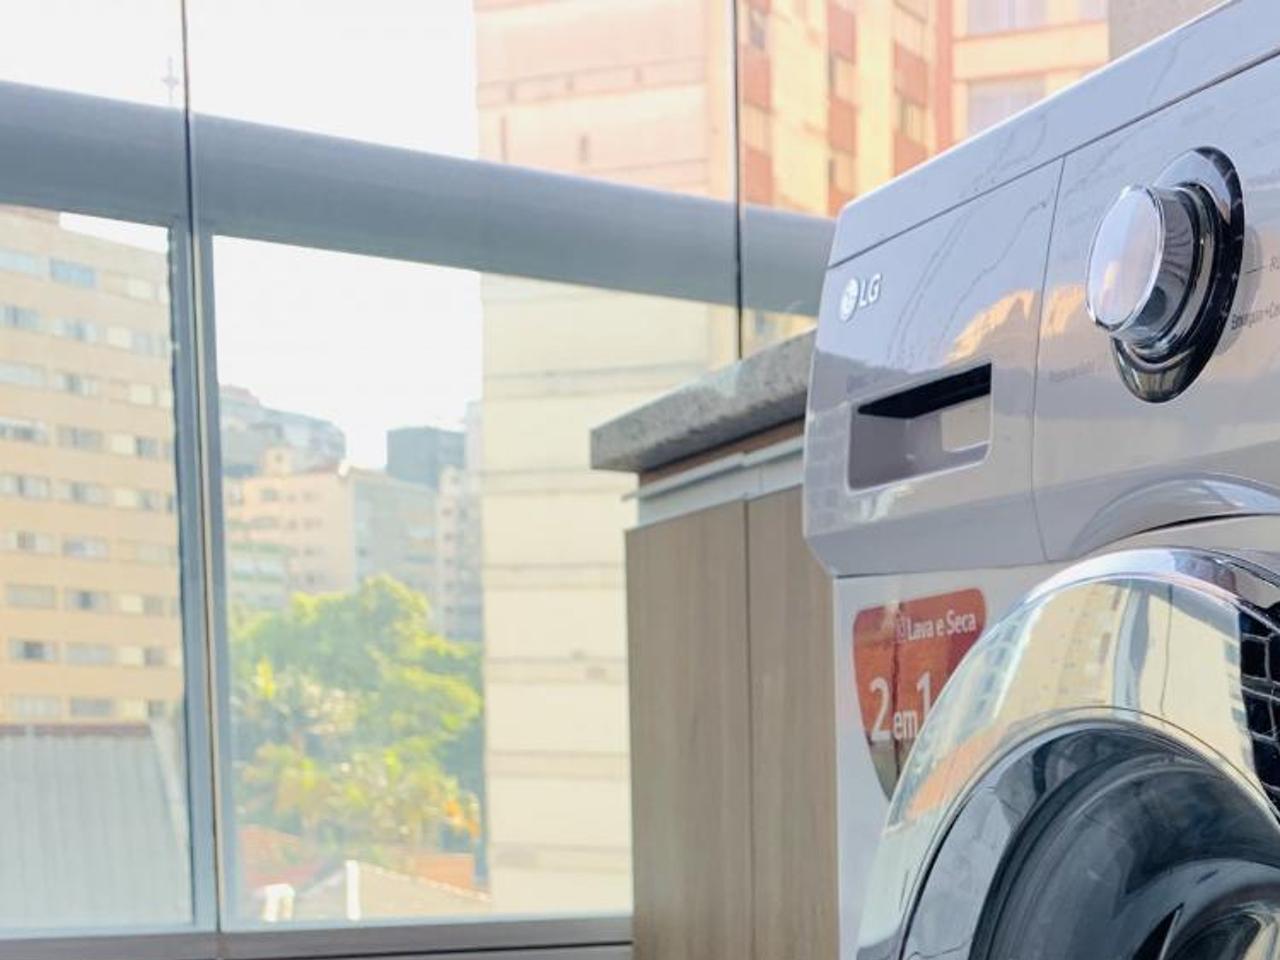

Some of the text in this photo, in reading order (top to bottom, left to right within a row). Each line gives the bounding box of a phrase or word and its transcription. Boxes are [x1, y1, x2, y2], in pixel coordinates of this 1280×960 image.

[858, 272, 883, 307] LG
[908, 609, 977, 641] Lava e Seca
[869, 675, 892, 741] 2
[893, 708, 918, 739] em
